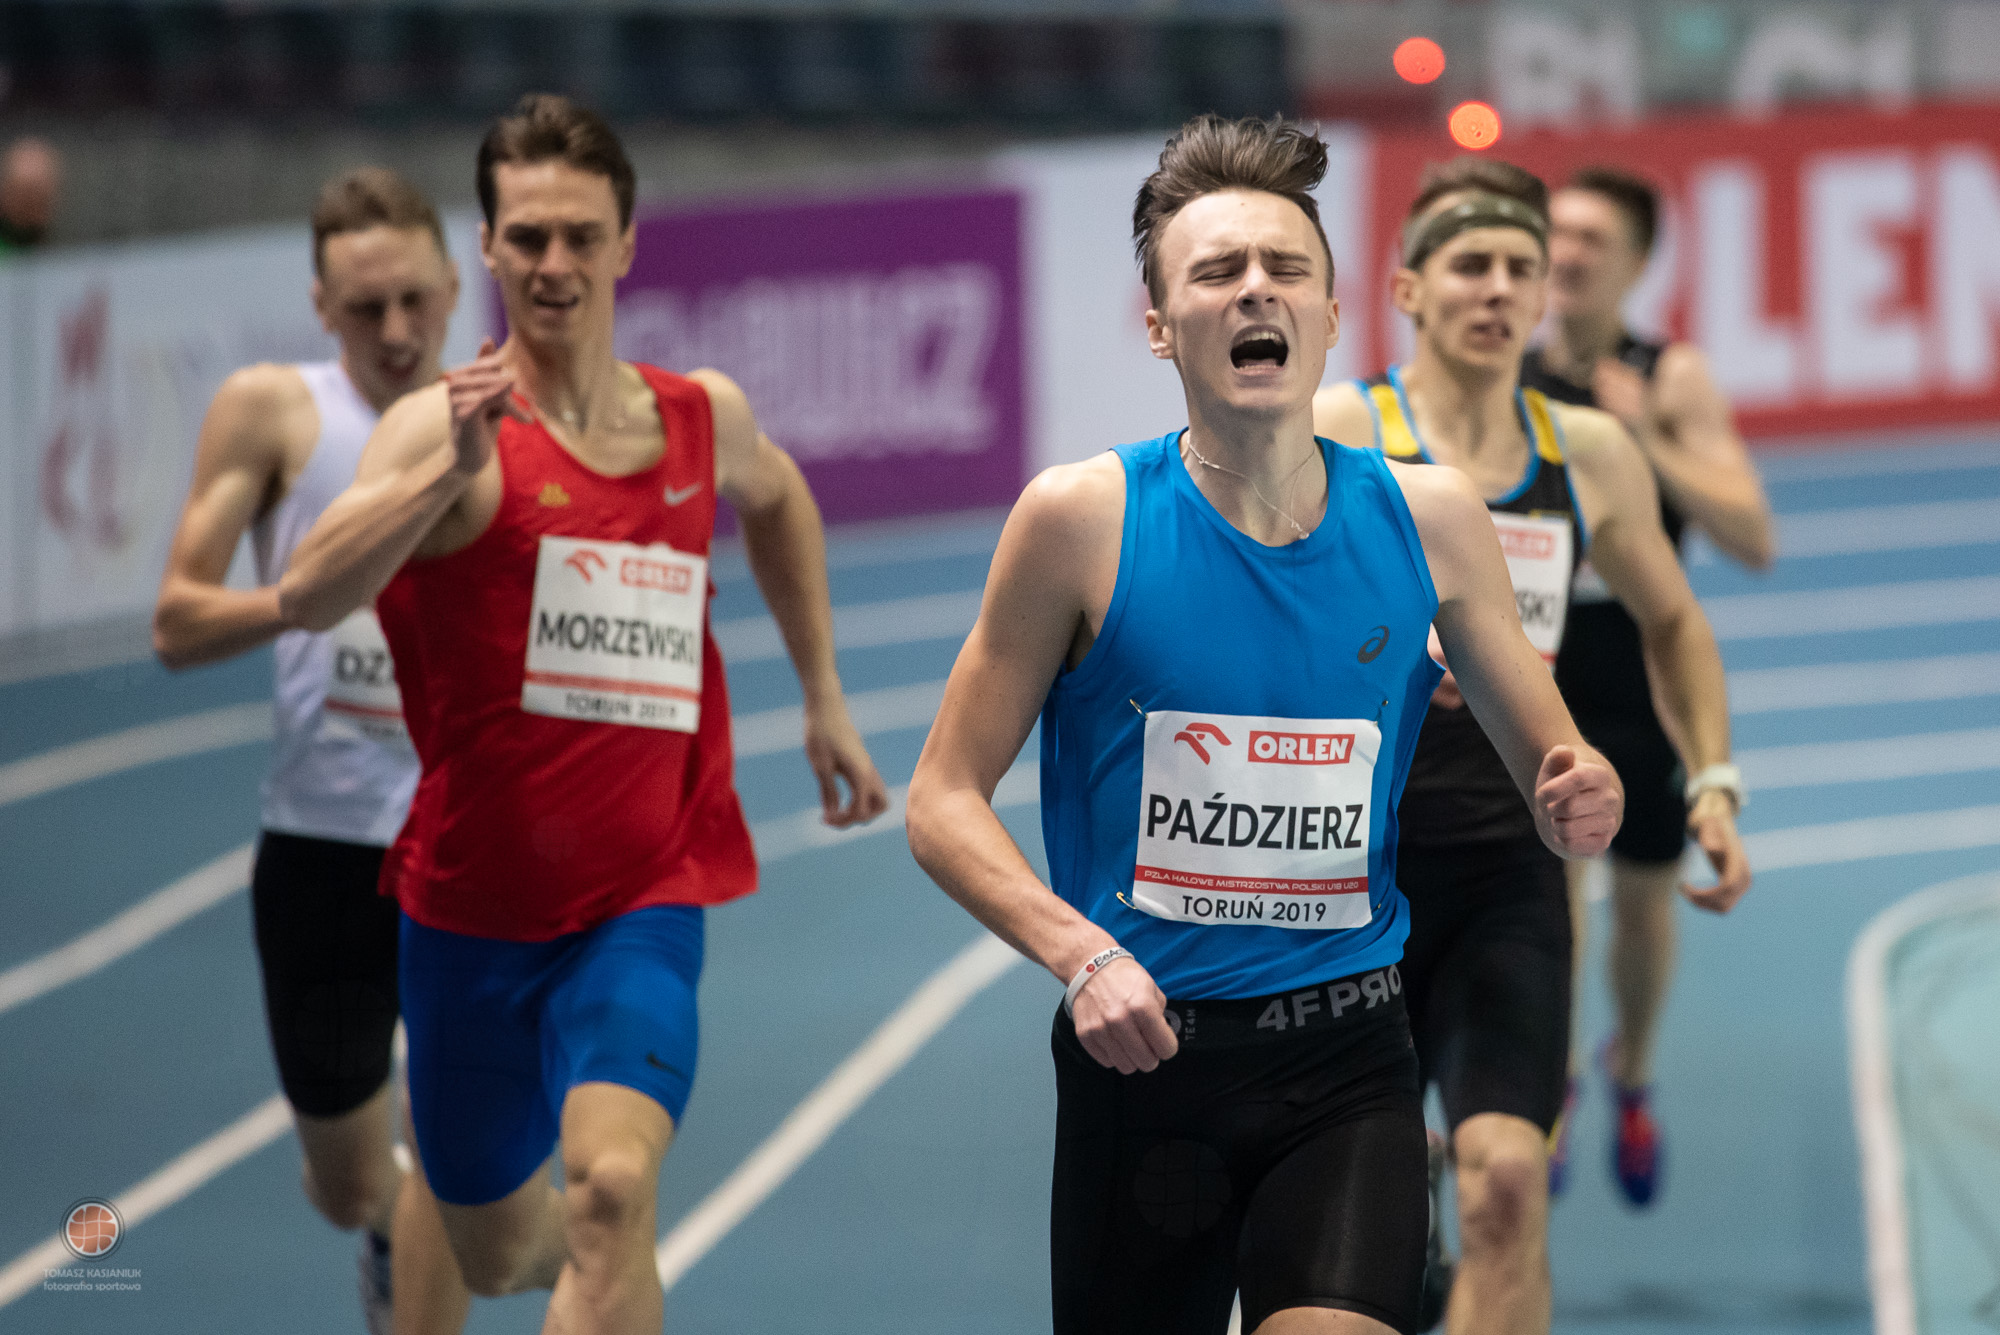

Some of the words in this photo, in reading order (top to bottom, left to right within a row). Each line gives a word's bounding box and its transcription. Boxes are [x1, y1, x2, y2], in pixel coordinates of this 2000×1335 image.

[537, 611, 695, 664] MORZEWSKI
[1253, 734, 1350, 762] ORLEN
[1146, 792, 1364, 851] PAŹDZIERZ
[1144, 870, 1171, 881] PZLA
[1172, 875, 1214, 887] HALOWE
[1216, 880, 1290, 891] MISTRZOSTWA
[1292, 882, 1326, 891] POLSKI
[1182, 895, 1264, 920] TORUŃ
[1271, 901, 1327, 922] 2019
[1256, 989, 1321, 1032] 4F
